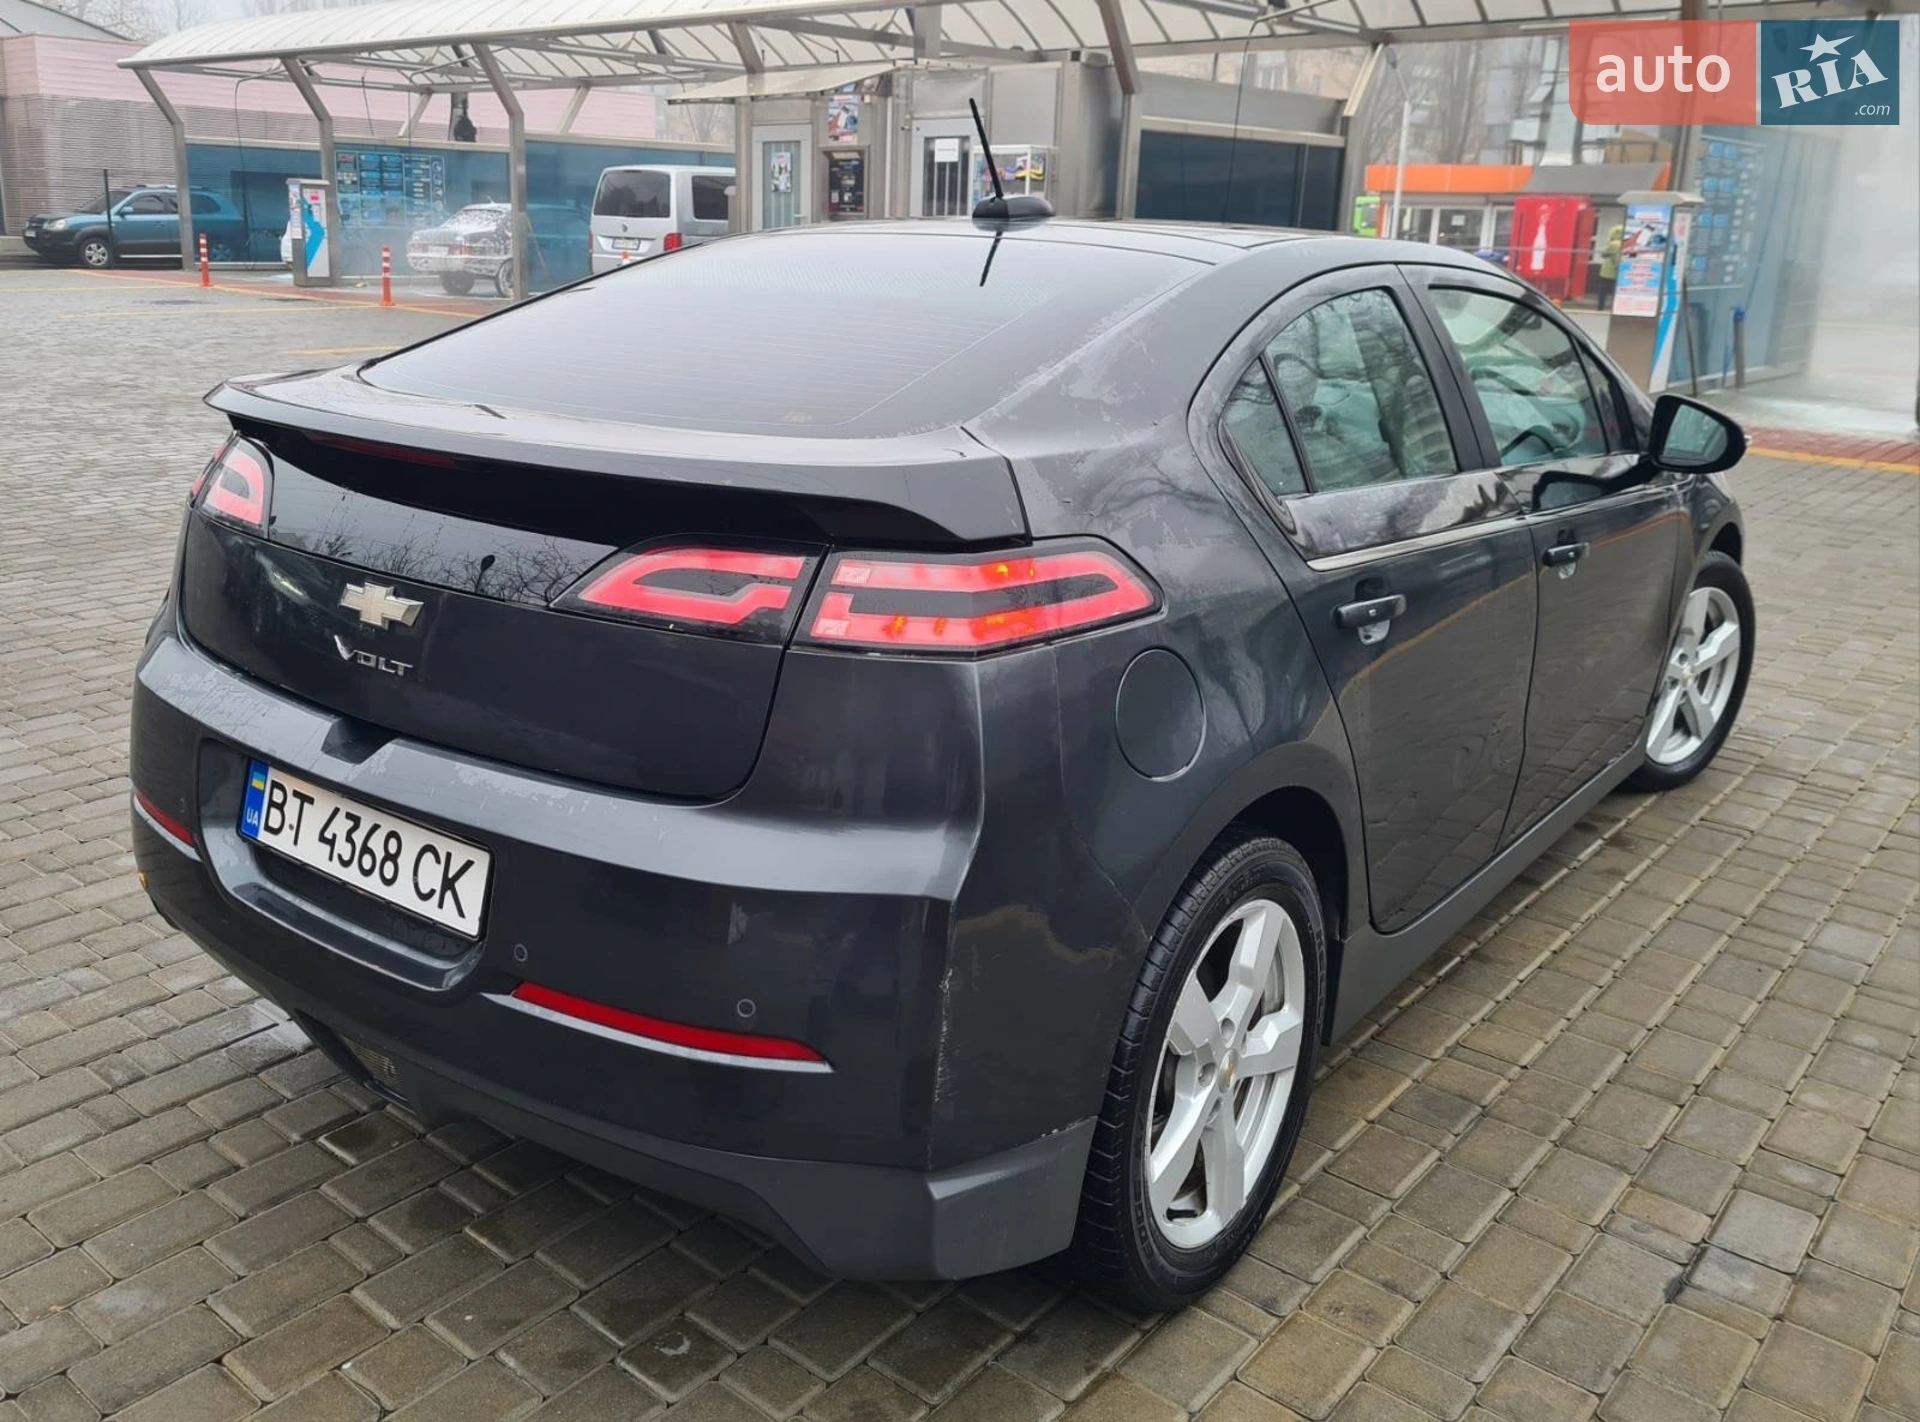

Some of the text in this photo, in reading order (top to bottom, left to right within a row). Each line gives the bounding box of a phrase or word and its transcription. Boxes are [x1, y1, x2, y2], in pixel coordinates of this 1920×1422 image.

[333, 635, 413, 677] VOLT
[246, 808, 260, 828] UA
[263, 780, 474, 919] BT 4368 CK
